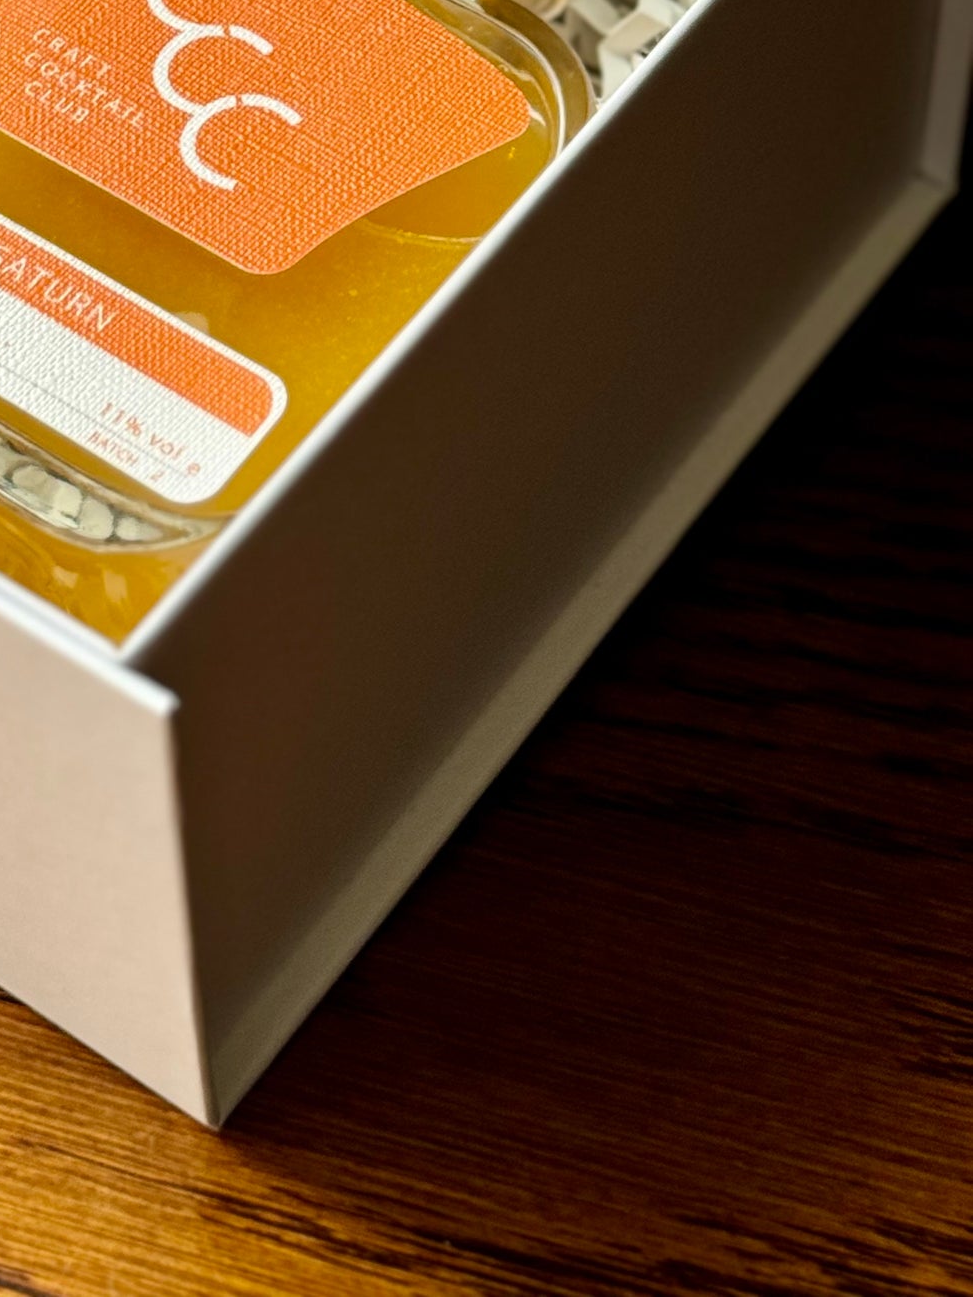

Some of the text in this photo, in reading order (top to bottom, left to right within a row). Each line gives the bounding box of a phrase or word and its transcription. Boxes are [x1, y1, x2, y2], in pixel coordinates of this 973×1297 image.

[32, 27, 111, 79] CRAFT
[24, 52, 146, 129] COCKTAIL
[24, 80, 89, 124] CLUB
[87, 430, 141, 468] BATCH
[100, 402, 142, 438] 11%
[149, 432, 186, 461] vol
